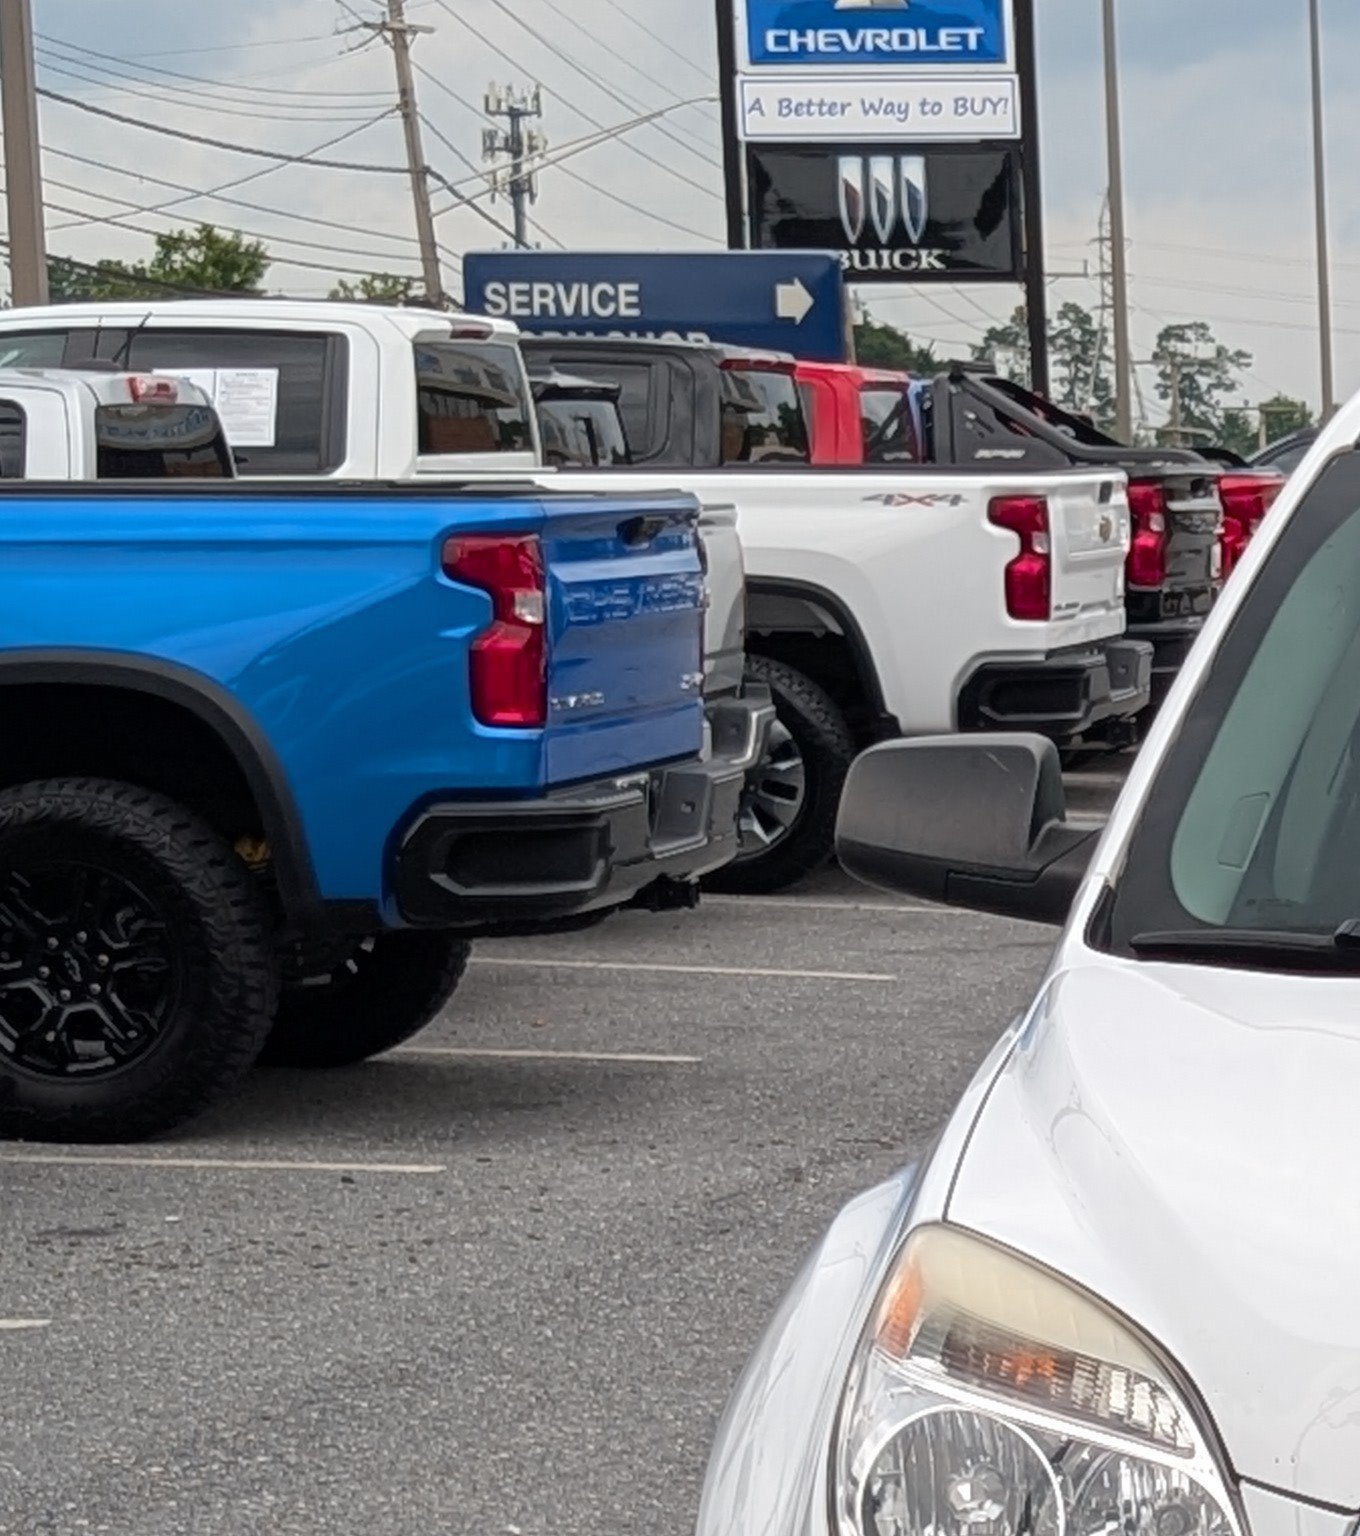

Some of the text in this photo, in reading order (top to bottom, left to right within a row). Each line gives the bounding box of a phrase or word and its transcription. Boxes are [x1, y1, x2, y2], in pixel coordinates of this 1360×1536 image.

[765, 27, 985, 53] CHEVROLET
[747, 97, 1008, 122] A Better Way to BUY!
[484, 281, 642, 317] SERVICE
